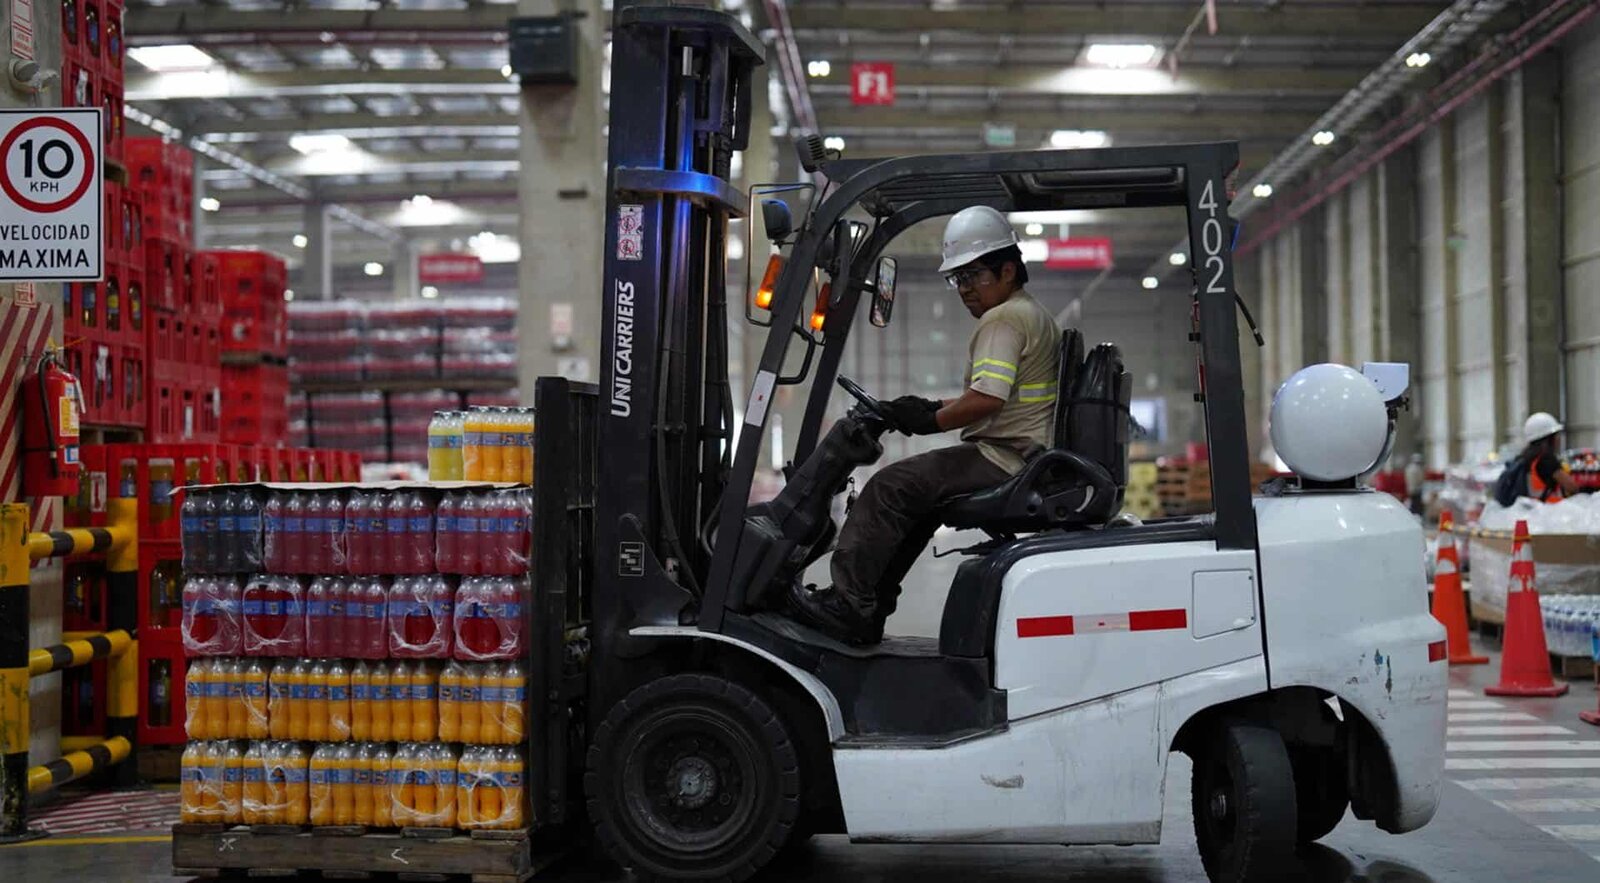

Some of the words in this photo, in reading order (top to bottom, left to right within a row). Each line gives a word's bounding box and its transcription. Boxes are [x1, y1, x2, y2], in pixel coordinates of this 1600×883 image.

[858, 71, 888, 97] F1
[19, 139, 74, 179] 10
[30, 181, 59, 193] KPH
[0, 224, 90, 241] VELOCIDAD
[1198, 179, 1226, 293] 402
[0, 249, 90, 269] MAXIMA
[611, 280, 635, 418] UNICARRIERS
